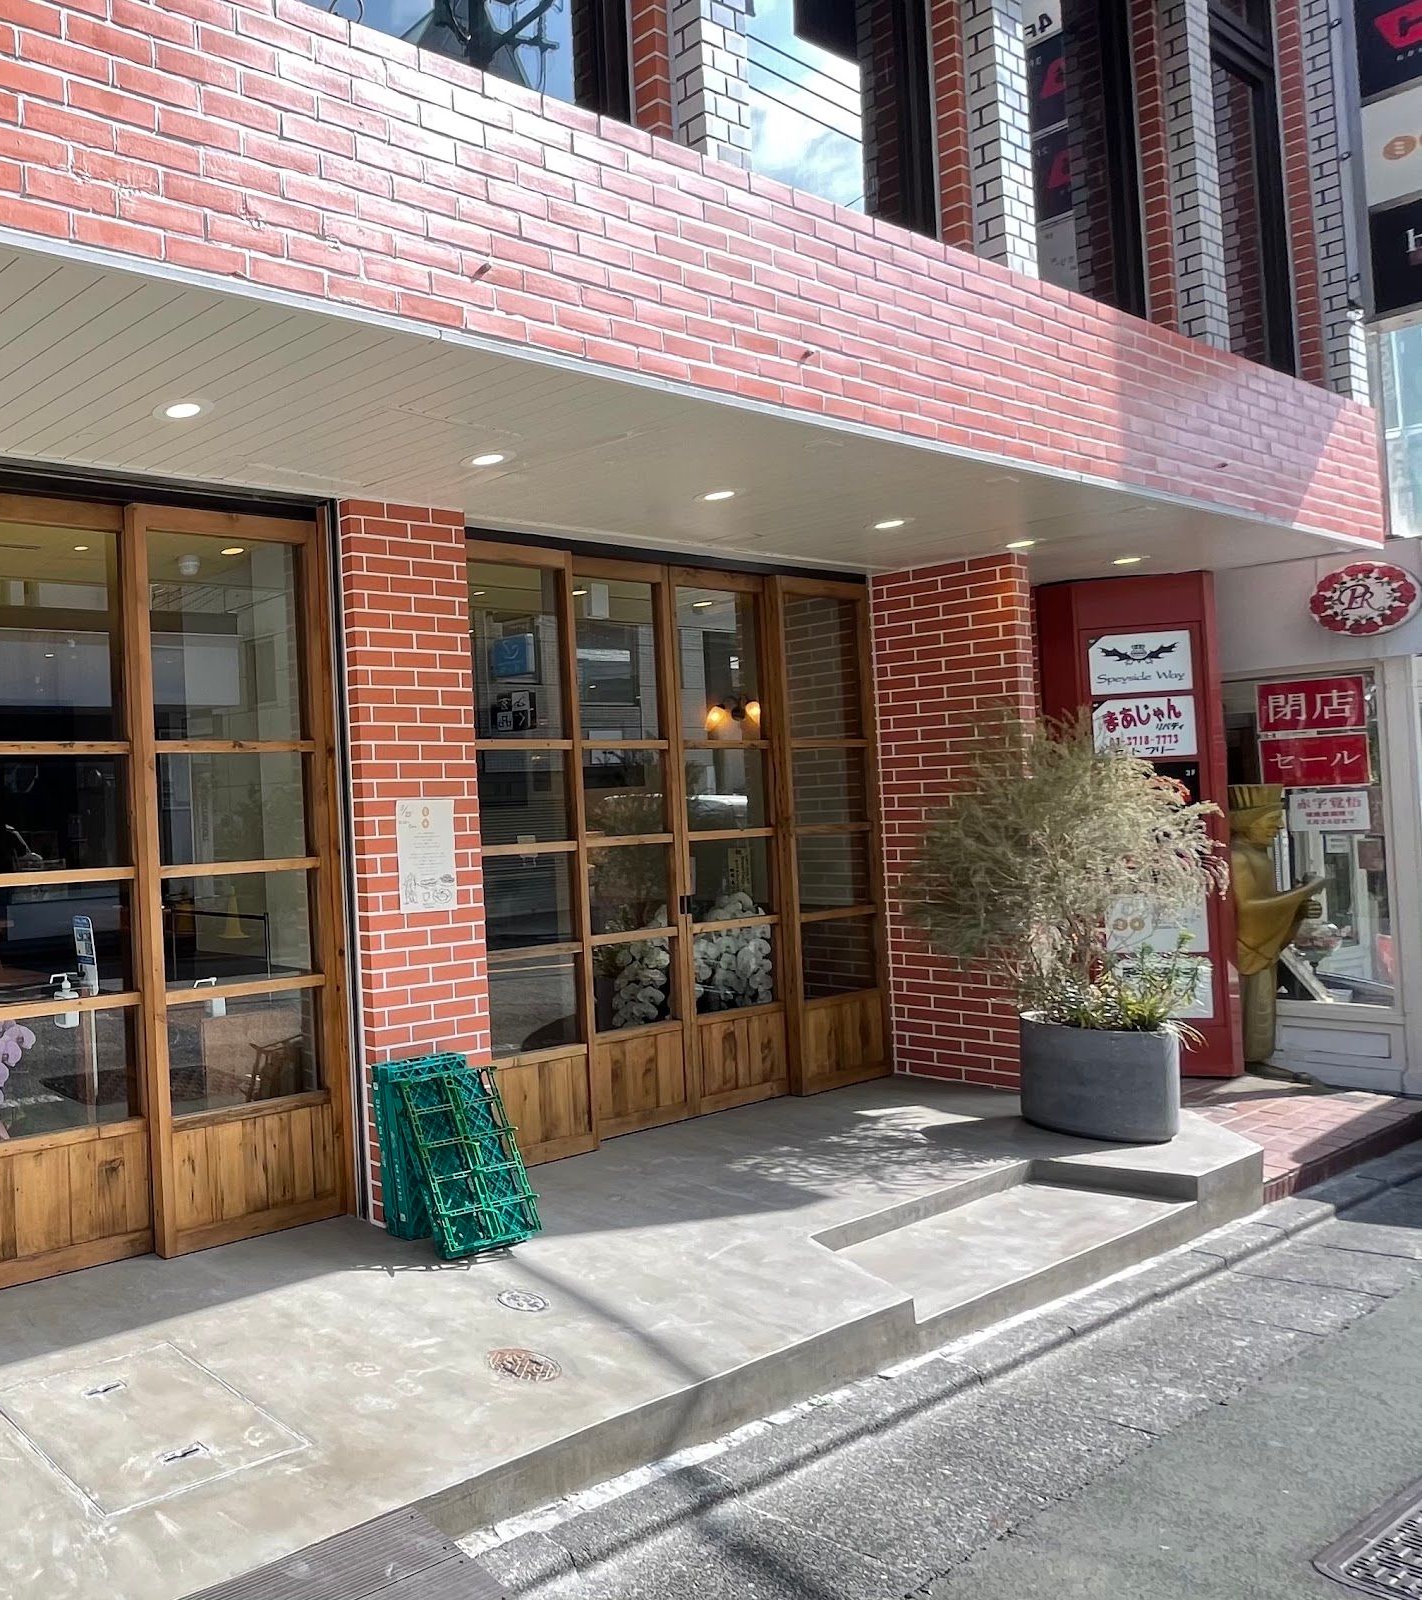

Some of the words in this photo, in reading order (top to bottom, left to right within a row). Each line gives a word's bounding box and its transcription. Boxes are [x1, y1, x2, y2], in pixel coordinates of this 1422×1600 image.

[1096, 671, 1152, 685] Speyside
[1156, 669, 1185, 681] Way
[1102, 698, 1182, 733] まあじゃん
[1268, 689, 1355, 723] 閉店
[1268, 750, 1362, 769] セール
